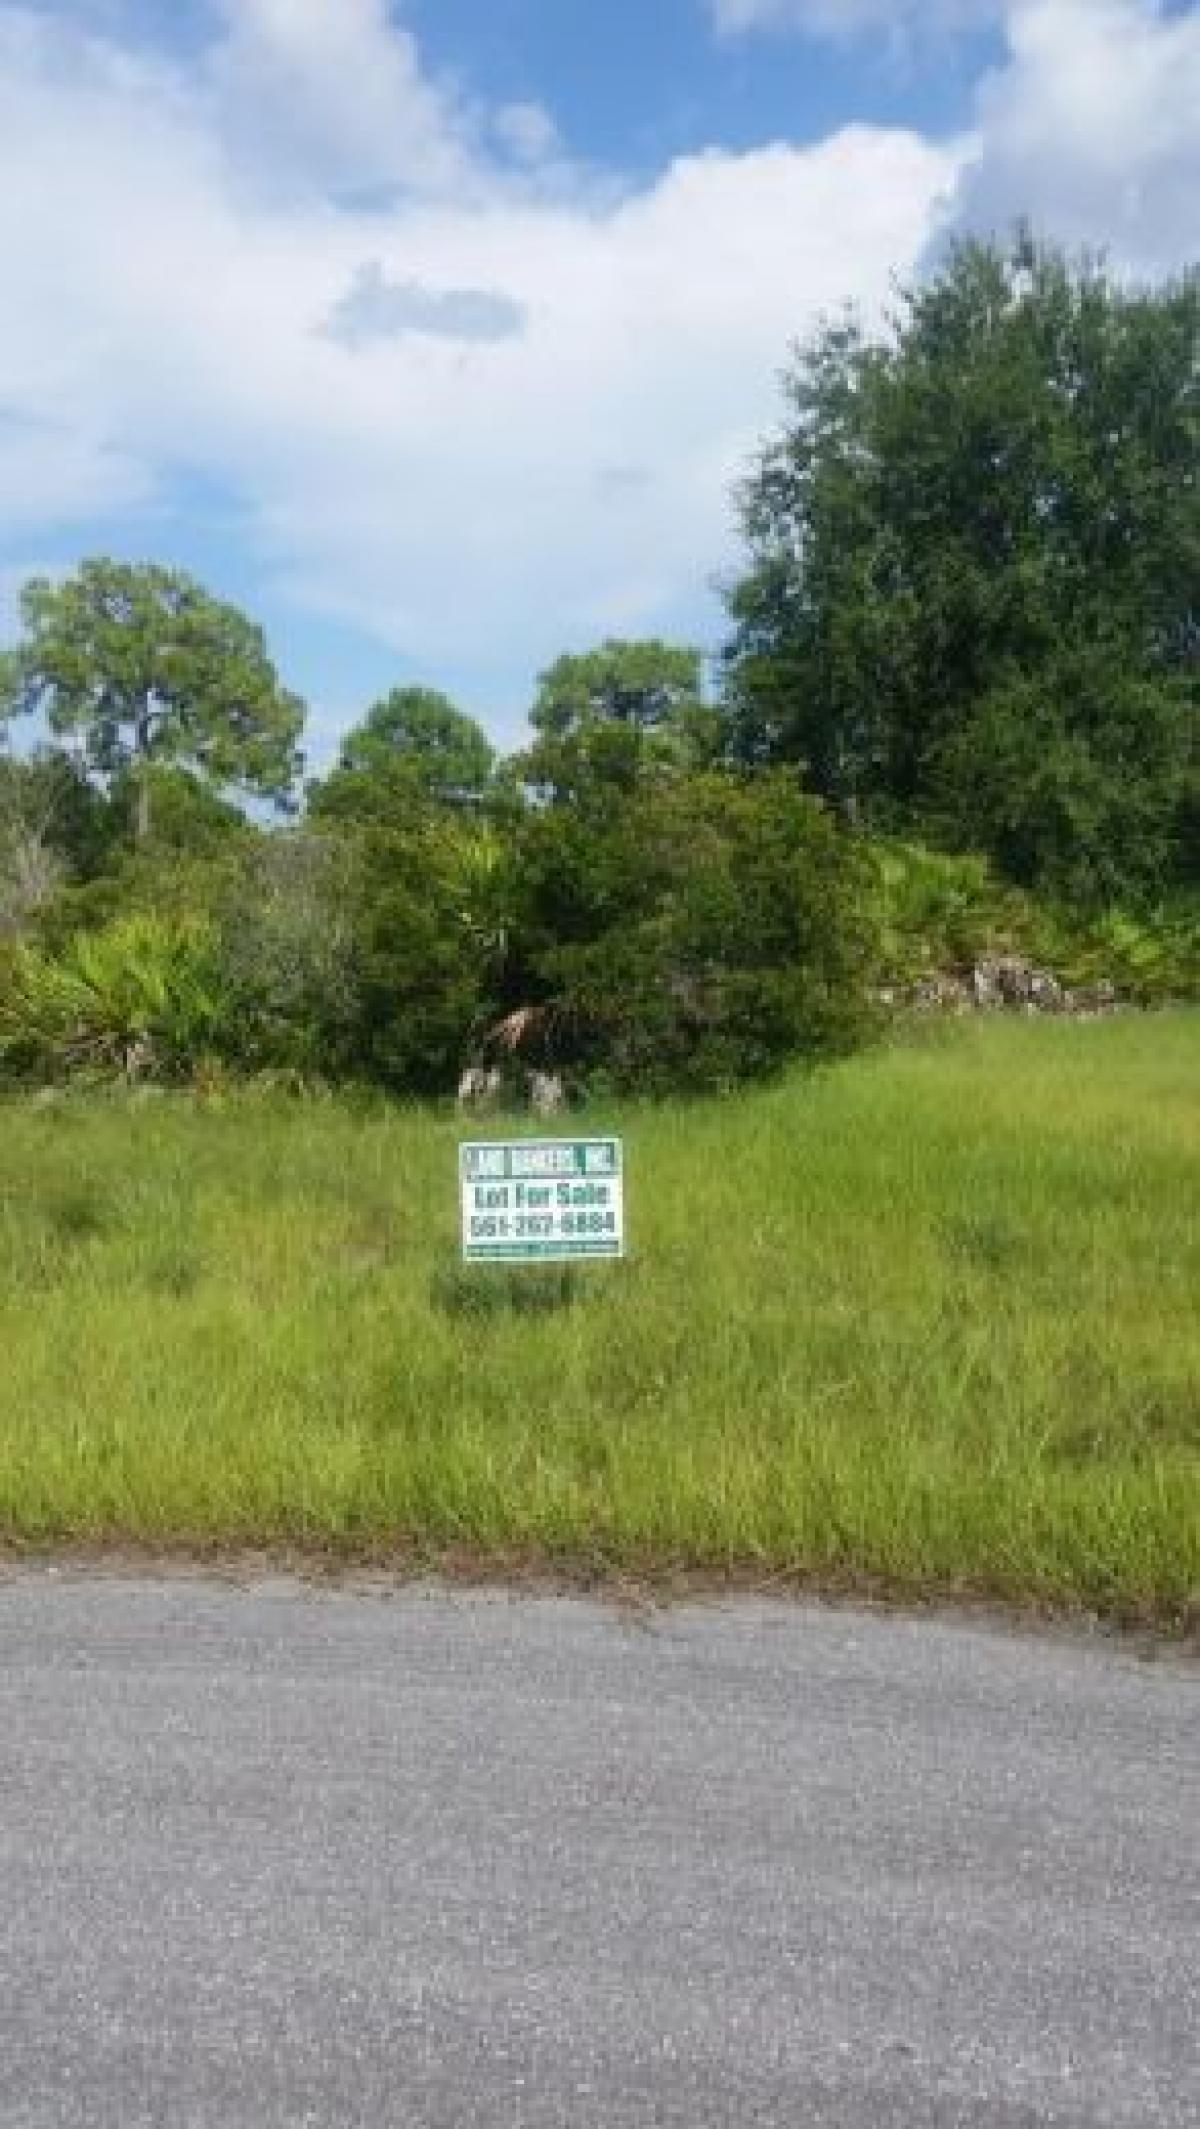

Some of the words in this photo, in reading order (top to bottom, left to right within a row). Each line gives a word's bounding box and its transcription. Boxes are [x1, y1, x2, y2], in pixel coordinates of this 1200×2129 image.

[474, 1186, 509, 1209] Lot
[515, 1183, 551, 1208] For
[556, 1182, 610, 1207] Sale
